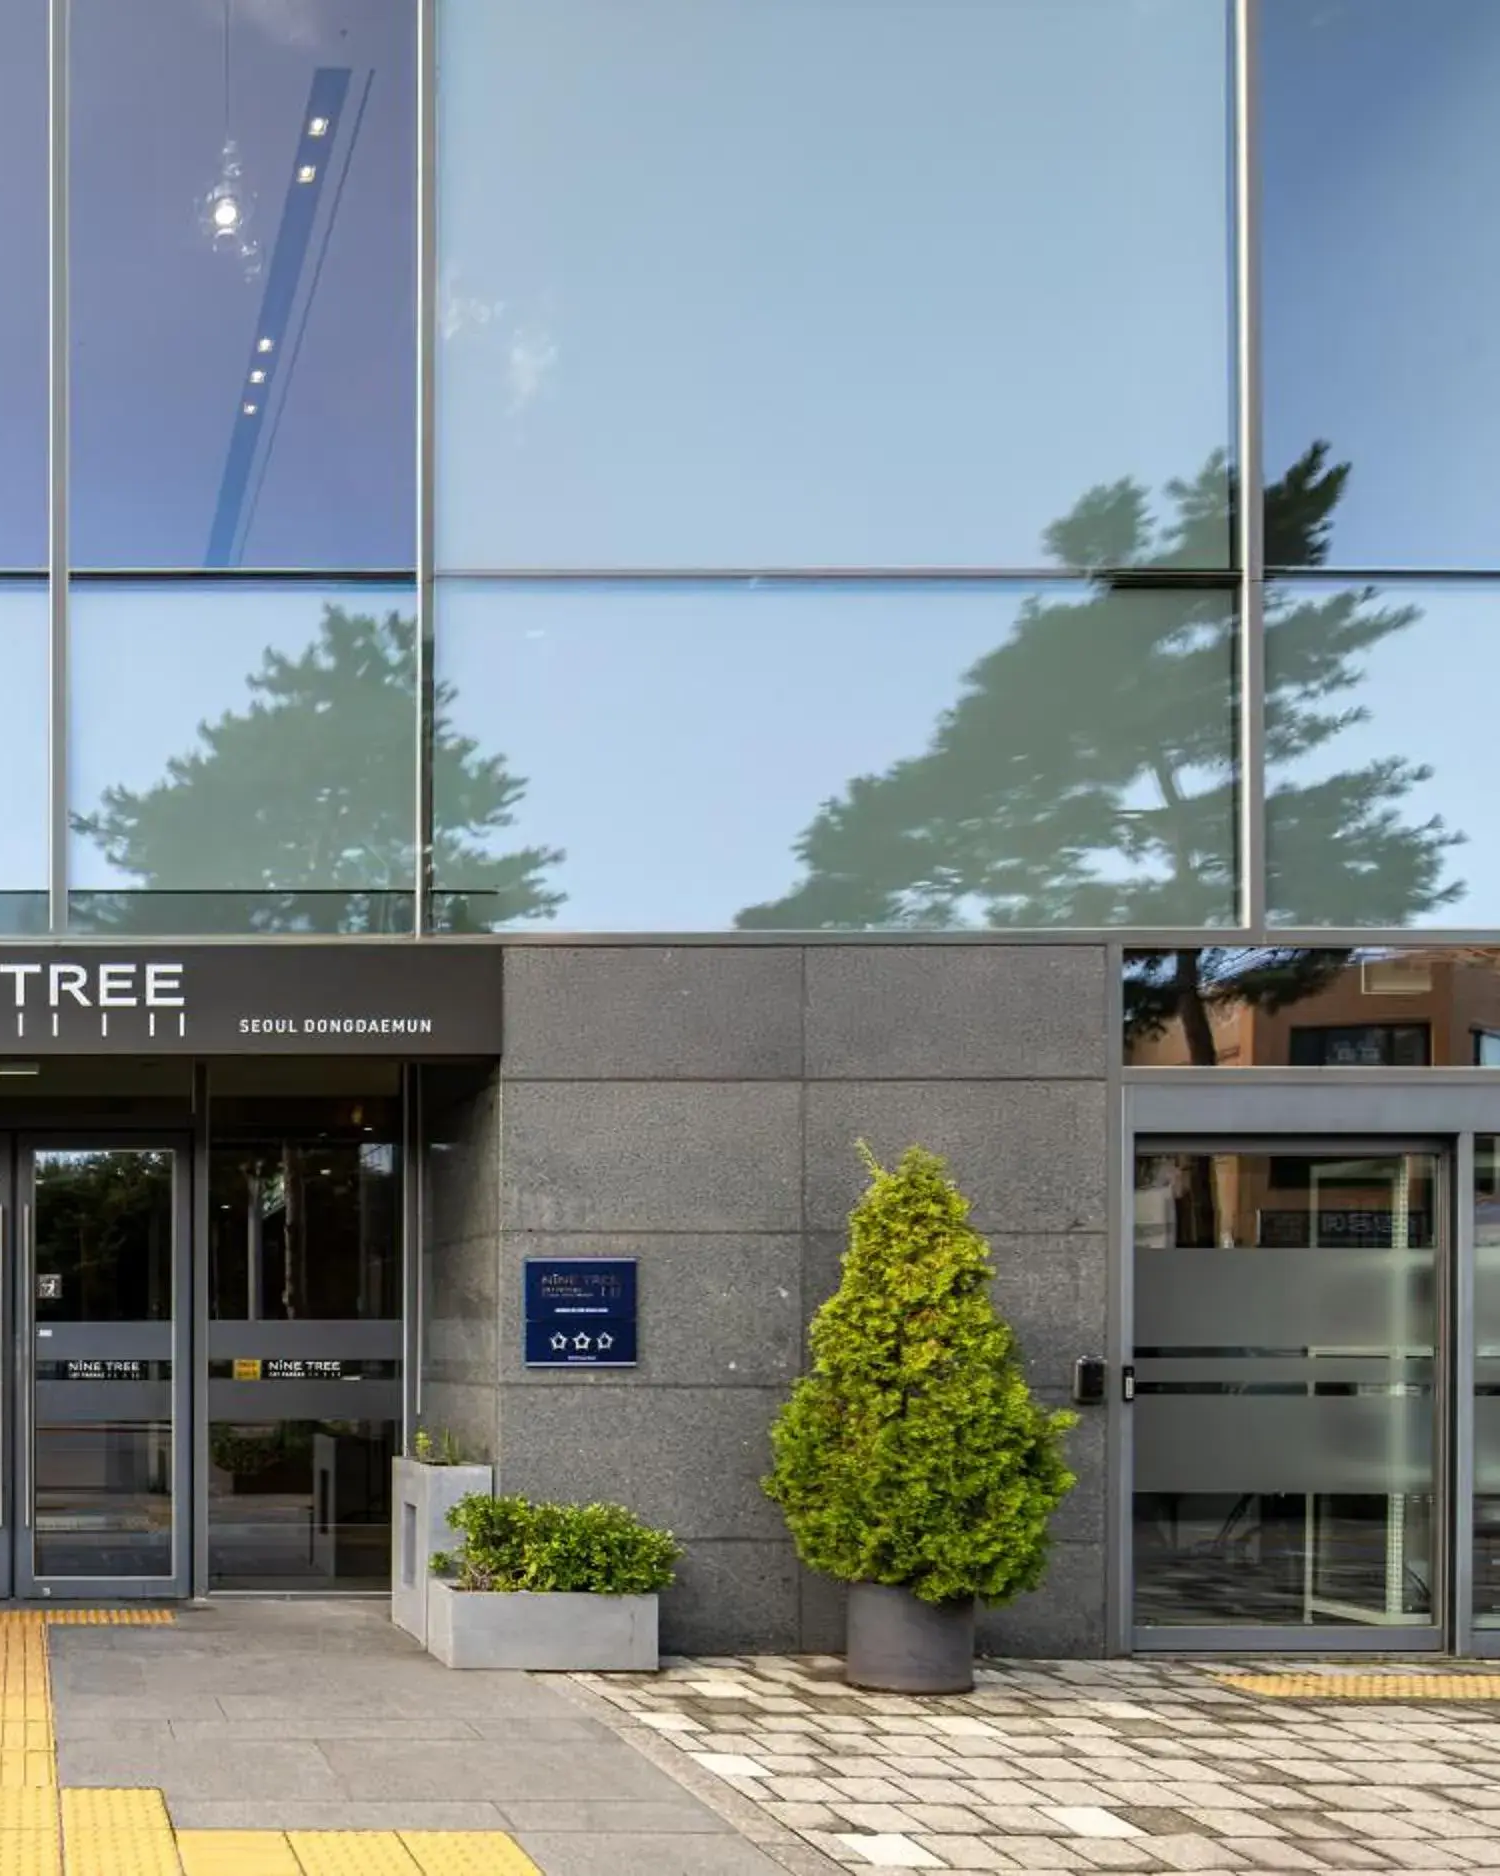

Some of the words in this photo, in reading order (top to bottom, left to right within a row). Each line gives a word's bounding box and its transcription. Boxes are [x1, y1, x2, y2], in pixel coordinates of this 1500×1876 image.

[239, 1018, 298, 1033] SEOUL
[303, 1018, 432, 1033] DONGDAEMUN
[305, 1361, 340, 1371] TREE
